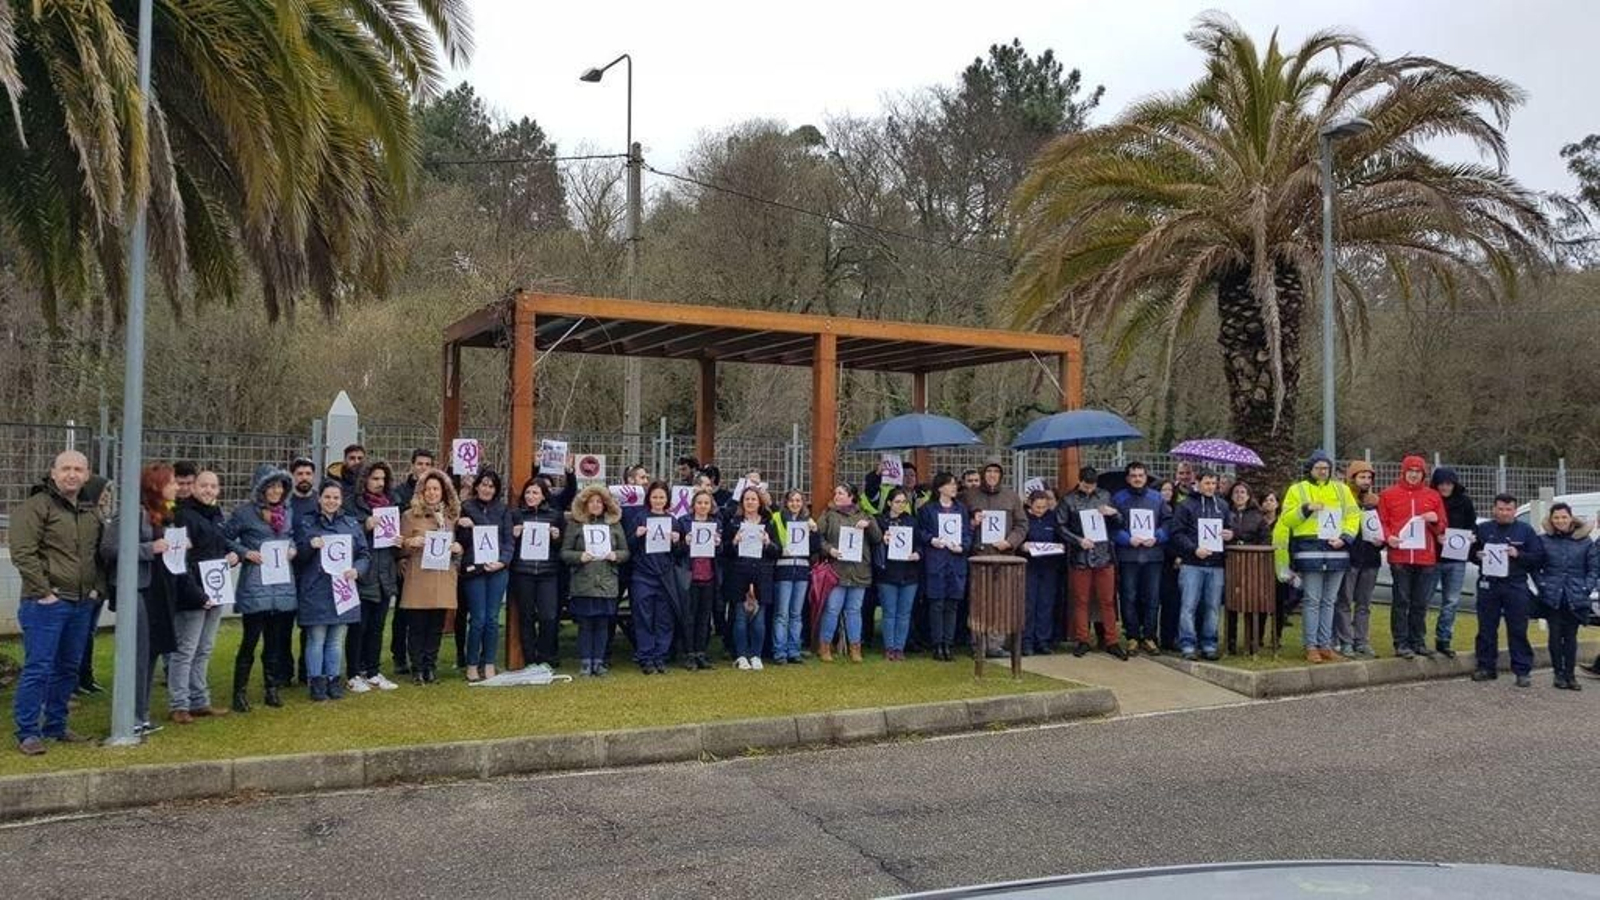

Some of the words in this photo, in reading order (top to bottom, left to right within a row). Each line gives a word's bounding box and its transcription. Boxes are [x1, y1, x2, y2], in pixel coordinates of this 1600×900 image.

[943, 519, 957, 535] C
[988, 516, 1001, 532] R
[1132, 513, 1152, 530] M
[1323, 512, 1337, 529] A
[1365, 516, 1378, 532] C
[529, 528, 542, 547] L
[589, 529, 607, 545] D
[651, 524, 666, 542] A
[695, 527, 712, 545] D
[791, 527, 806, 544] D
[895, 532, 906, 548] S
[1203, 524, 1218, 540] N
[430, 537, 447, 557] U
[478, 532, 494, 551] A
[1447, 533, 1466, 551] O
[327, 541, 346, 562] G
[1488, 549, 1503, 565] N
